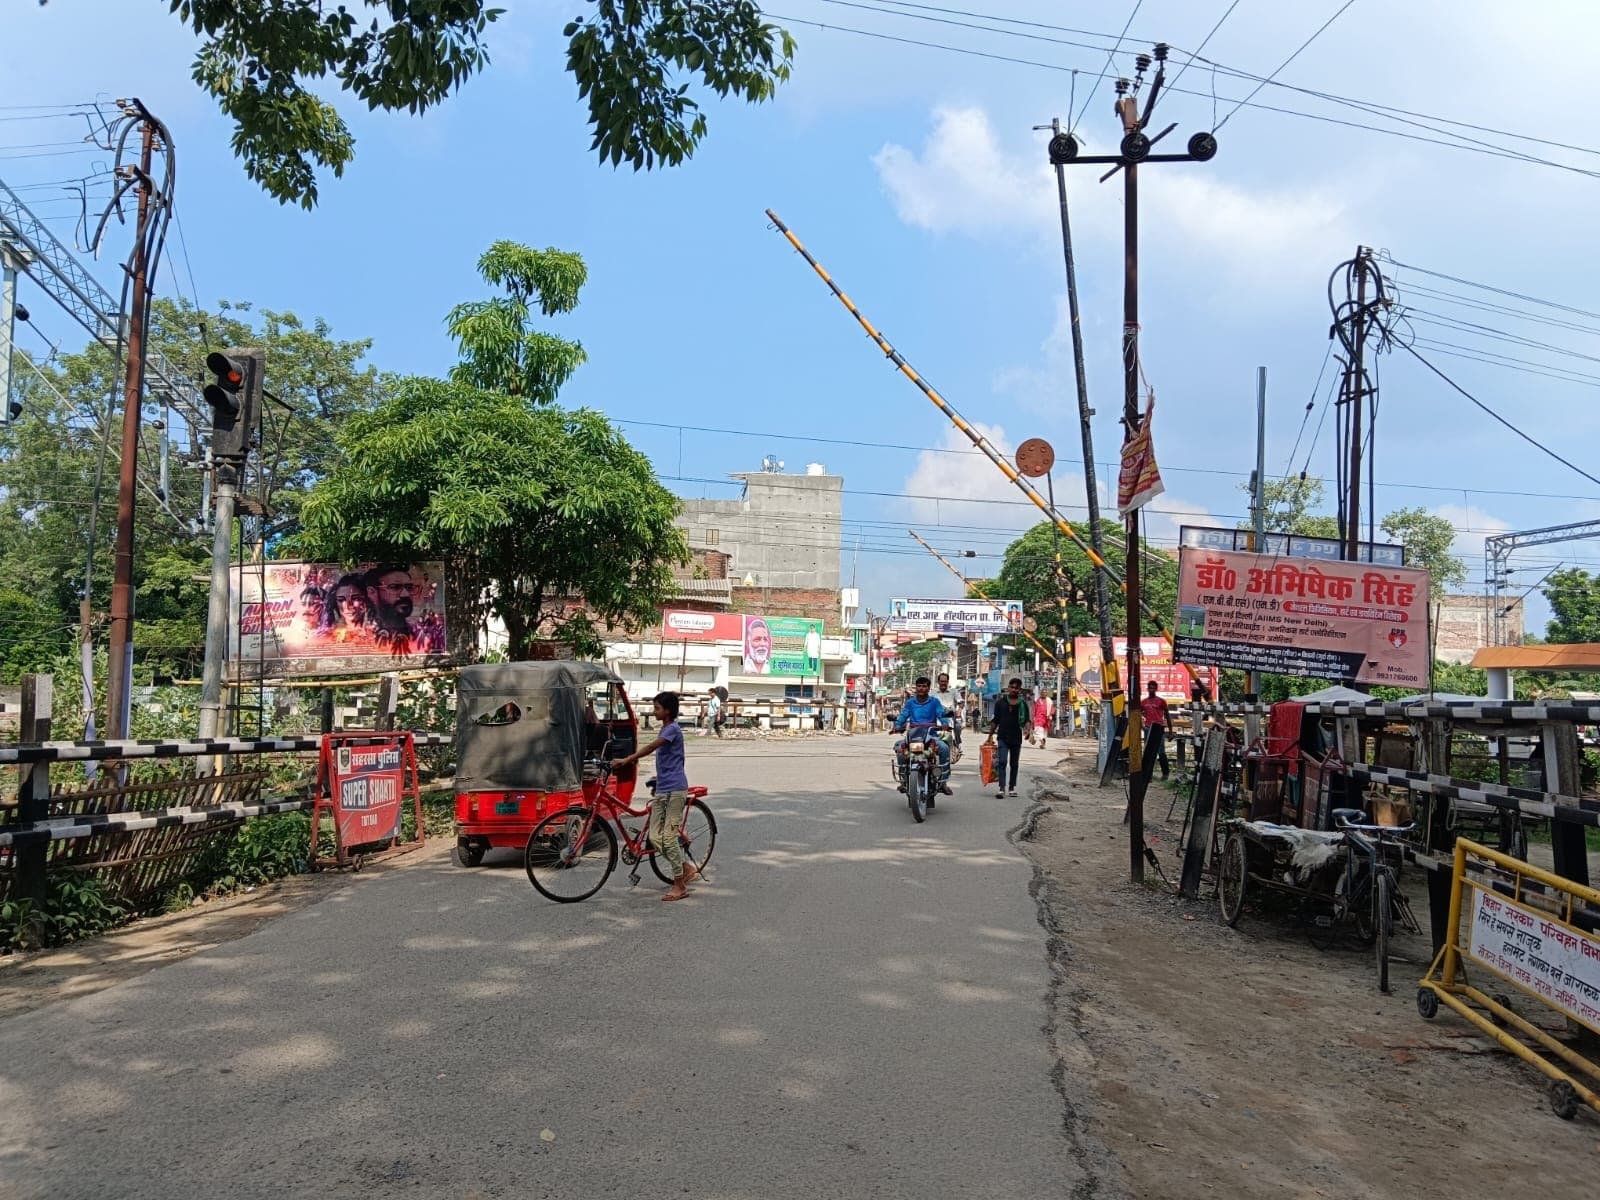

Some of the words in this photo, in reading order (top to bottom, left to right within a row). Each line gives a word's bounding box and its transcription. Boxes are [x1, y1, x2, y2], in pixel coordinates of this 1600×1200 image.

[1247, 563, 1356, 600] अभिषेक
[1361, 572, 1416, 607] सिंह
[1283, 616, 1302, 624] New
[352, 752, 377, 766] सहरसा
[377, 748, 399, 769] पुलिस
[343, 780, 368, 807] SUPER
[369, 778, 396, 805] SHAKTI
[1482, 893, 1502, 913] बिहार
[1505, 906, 1535, 929] सरकार
[1540, 921, 1578, 952] परिवहन
